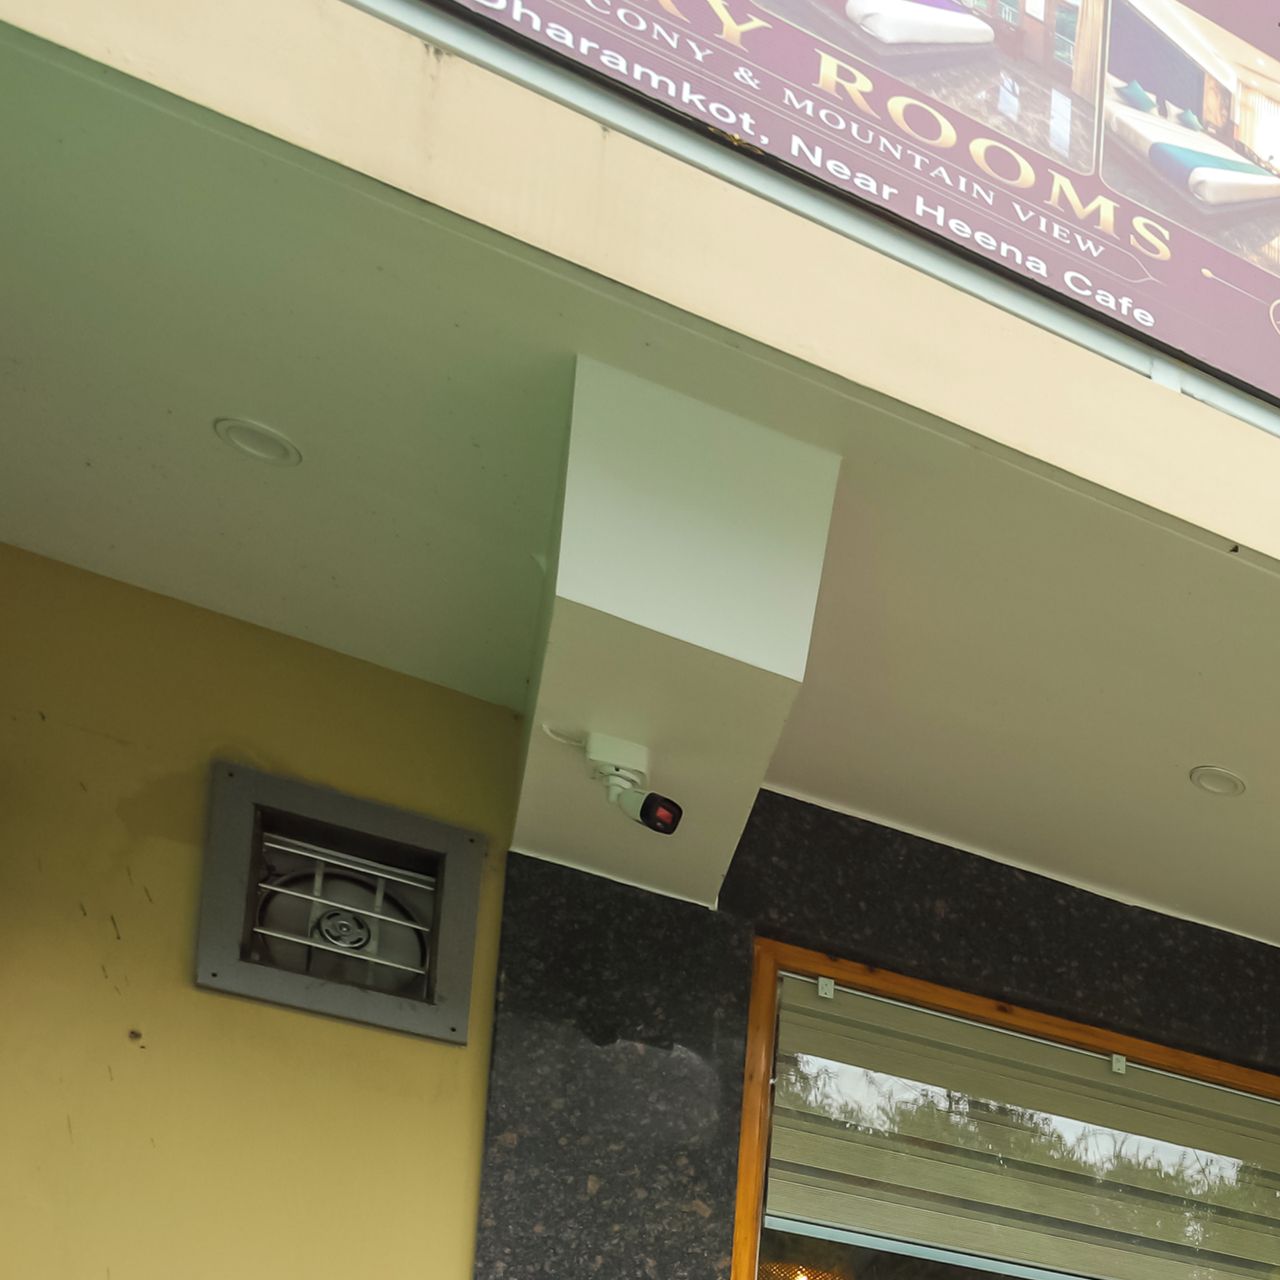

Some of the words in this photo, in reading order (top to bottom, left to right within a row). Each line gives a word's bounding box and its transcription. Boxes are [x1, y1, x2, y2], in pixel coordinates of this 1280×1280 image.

[733, 66, 761, 90] &
[783, 87, 996, 206] MOUNTAIN
[1012, 201, 1105, 258] VIEW
[790, 134, 898, 202] Near
[915, 195, 1049, 278] Heena
[1063, 270, 1155, 328] Cafe
[813, 48, 1171, 261] ROOMS
